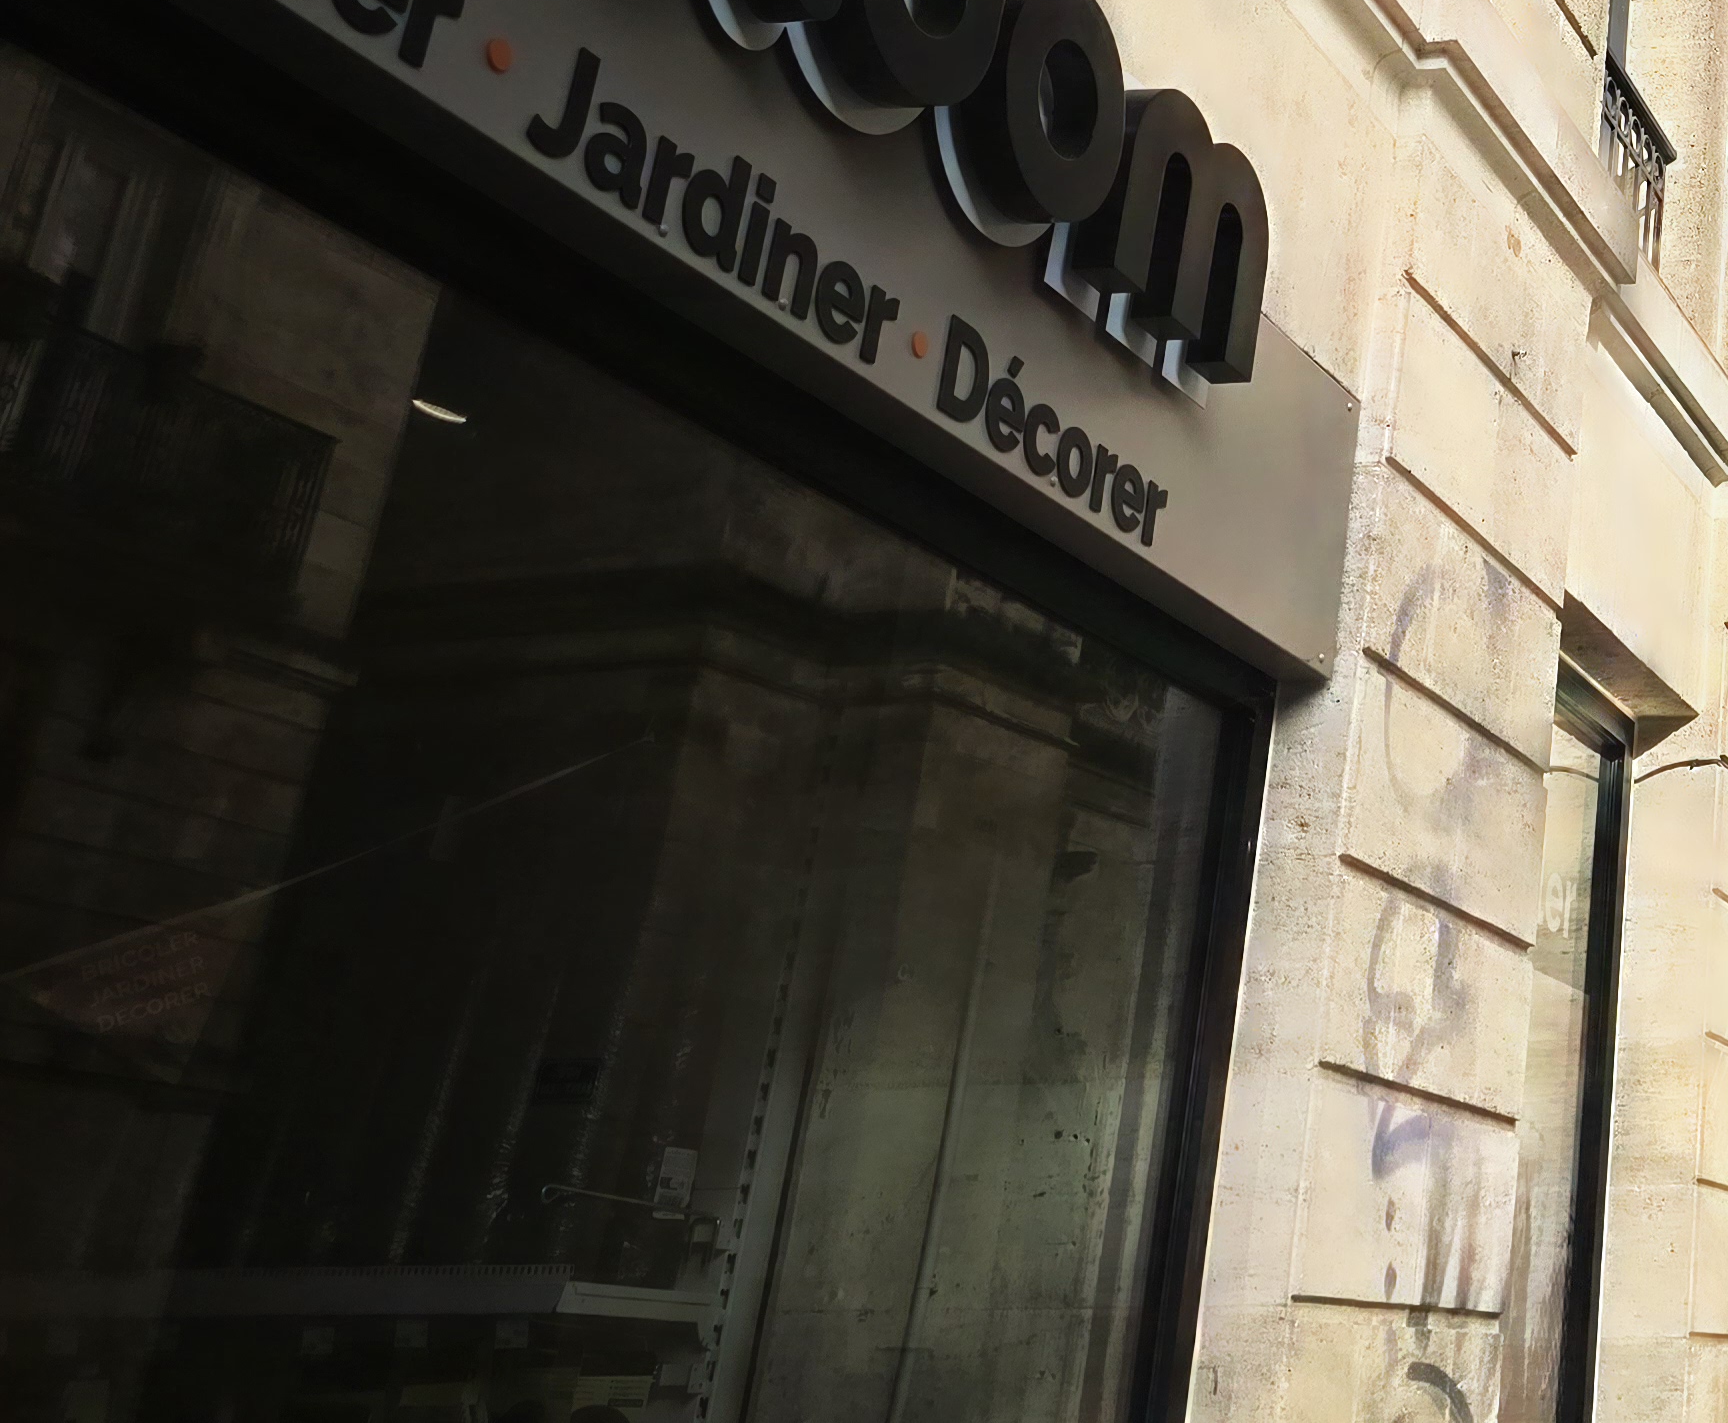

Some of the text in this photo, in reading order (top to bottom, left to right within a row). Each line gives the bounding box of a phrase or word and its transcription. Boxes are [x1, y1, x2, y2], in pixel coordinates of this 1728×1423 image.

[526, 46, 899, 364] Jardiner
[936, 313, 1168, 546] Décorer
[1538, 873, 1577, 939] er
[81, 931, 198, 982] BRICOLER
[91, 956, 206, 1007] JARDINER
[97, 981, 212, 1033] DECORER
